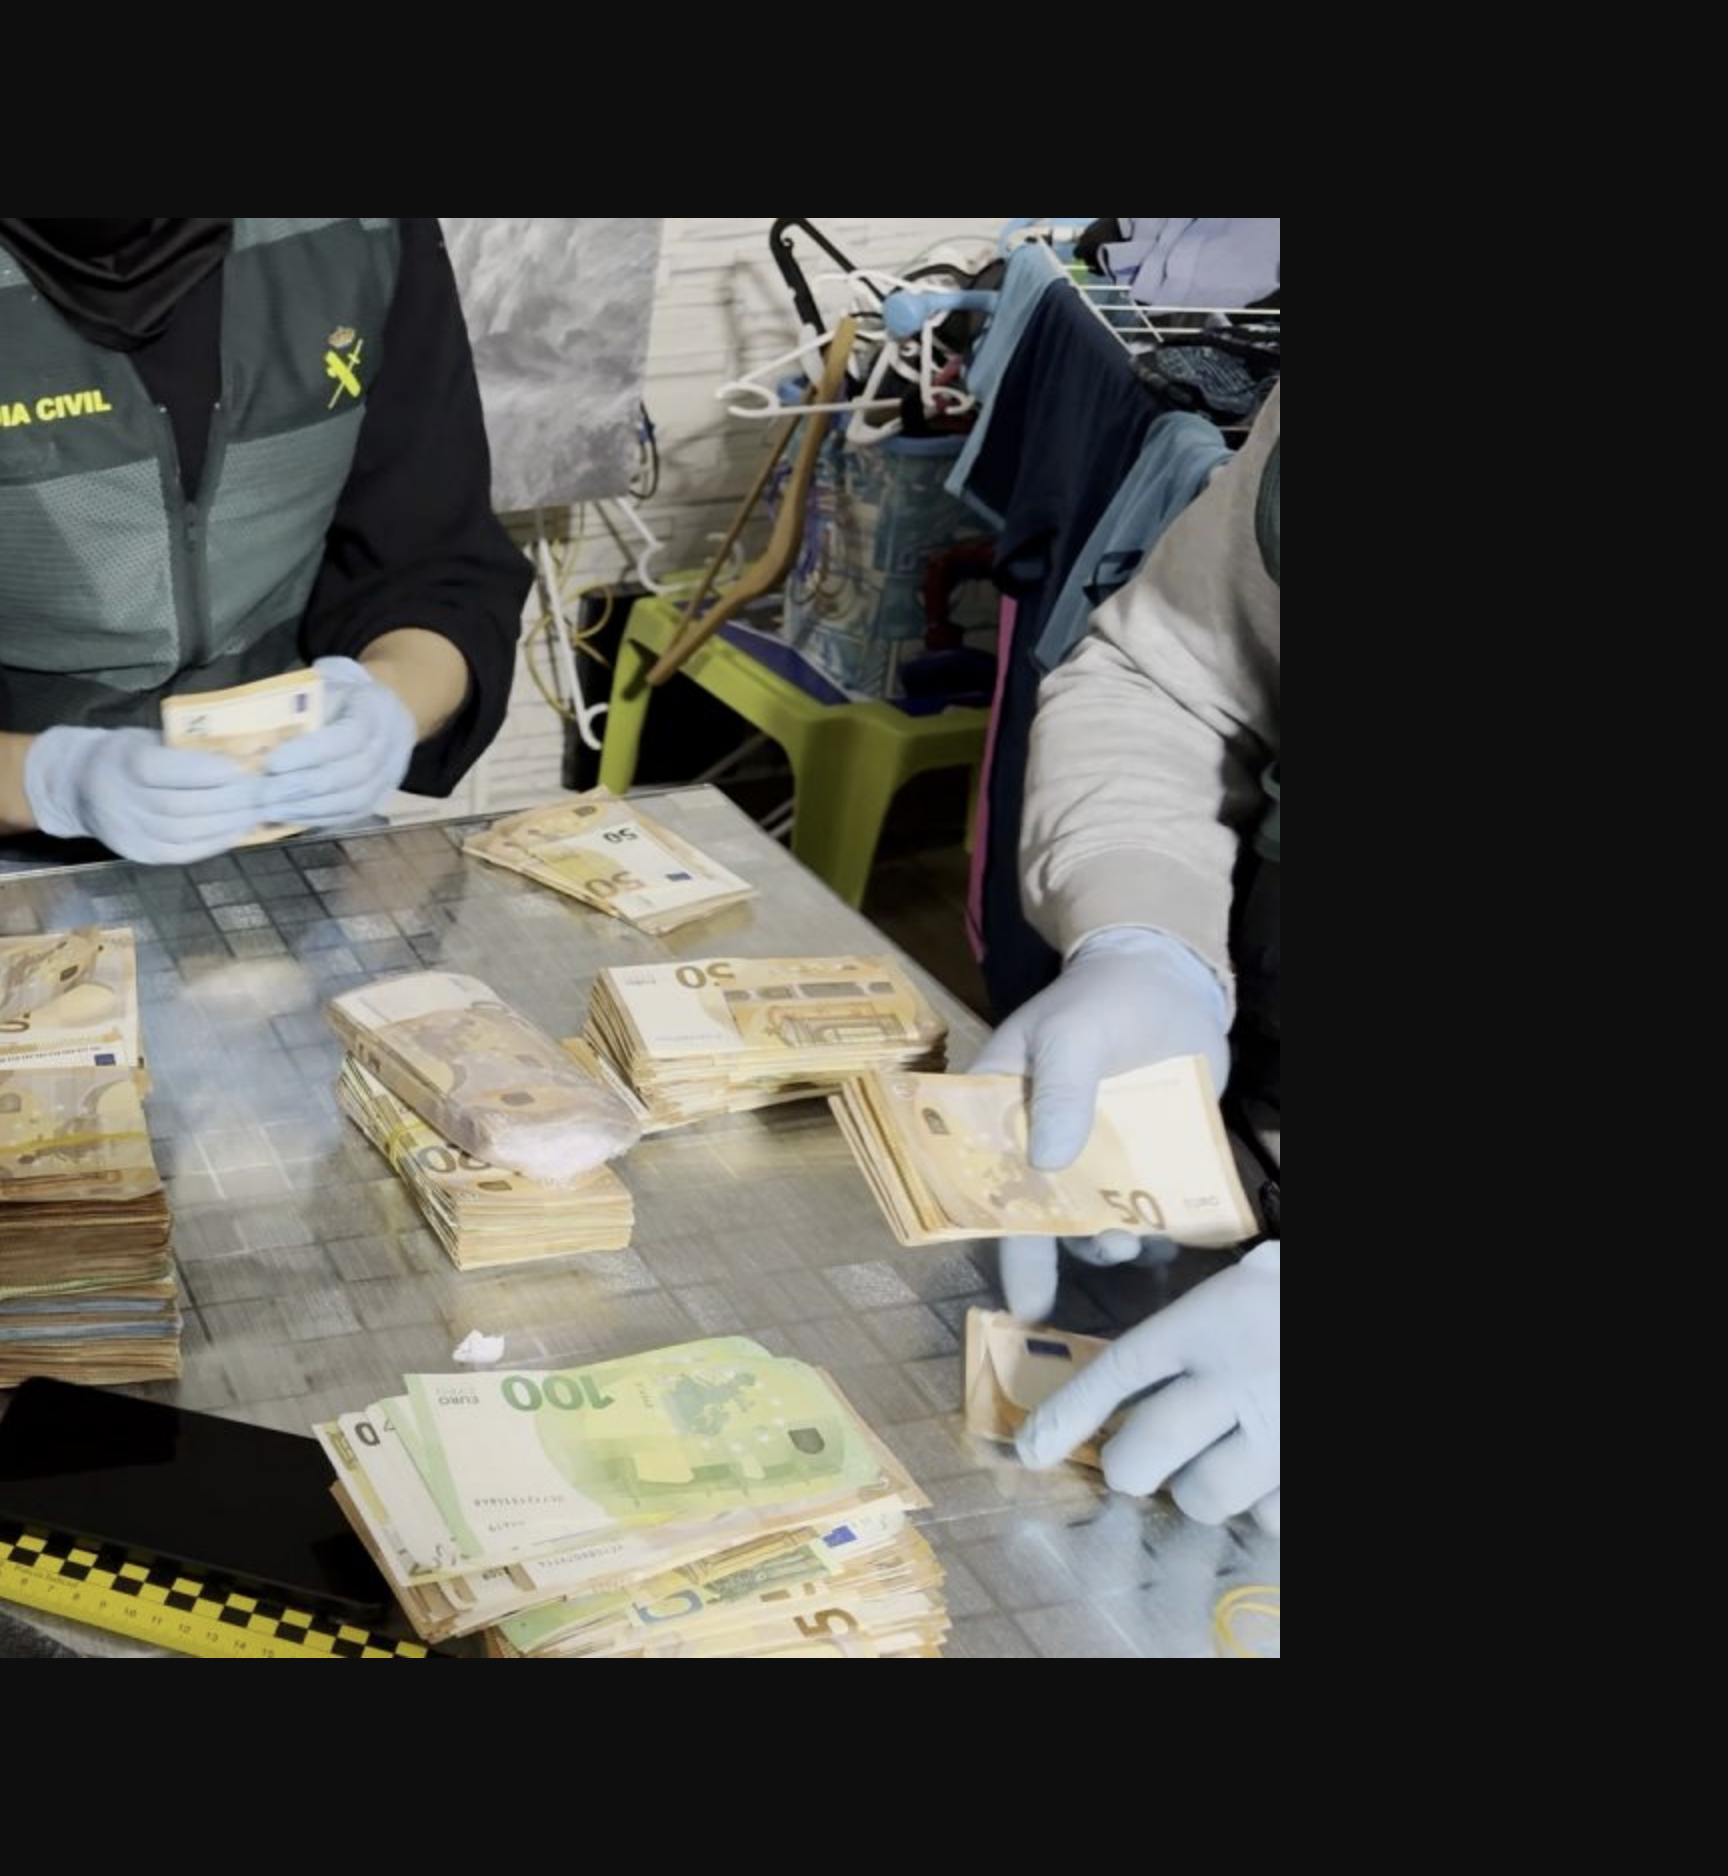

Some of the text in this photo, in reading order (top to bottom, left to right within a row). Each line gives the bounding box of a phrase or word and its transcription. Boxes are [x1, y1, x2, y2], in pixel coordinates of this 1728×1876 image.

[35, 389, 112, 421] CIVIL
[603, 827, 638, 844] 50
[584, 871, 646, 899] 50
[675, 961, 736, 990] 50
[1098, 1189, 1166, 1230] 50
[500, 1374, 616, 1412] 100
[124, 1608, 137, 1618] 10
[151, 1615, 163, 1626] 11
[179, 1623, 191, 1634] 12
[206, 1631, 219, 1643] 13
[233, 1640, 247, 1650] 14
[262, 1647, 275, 1658] 15
